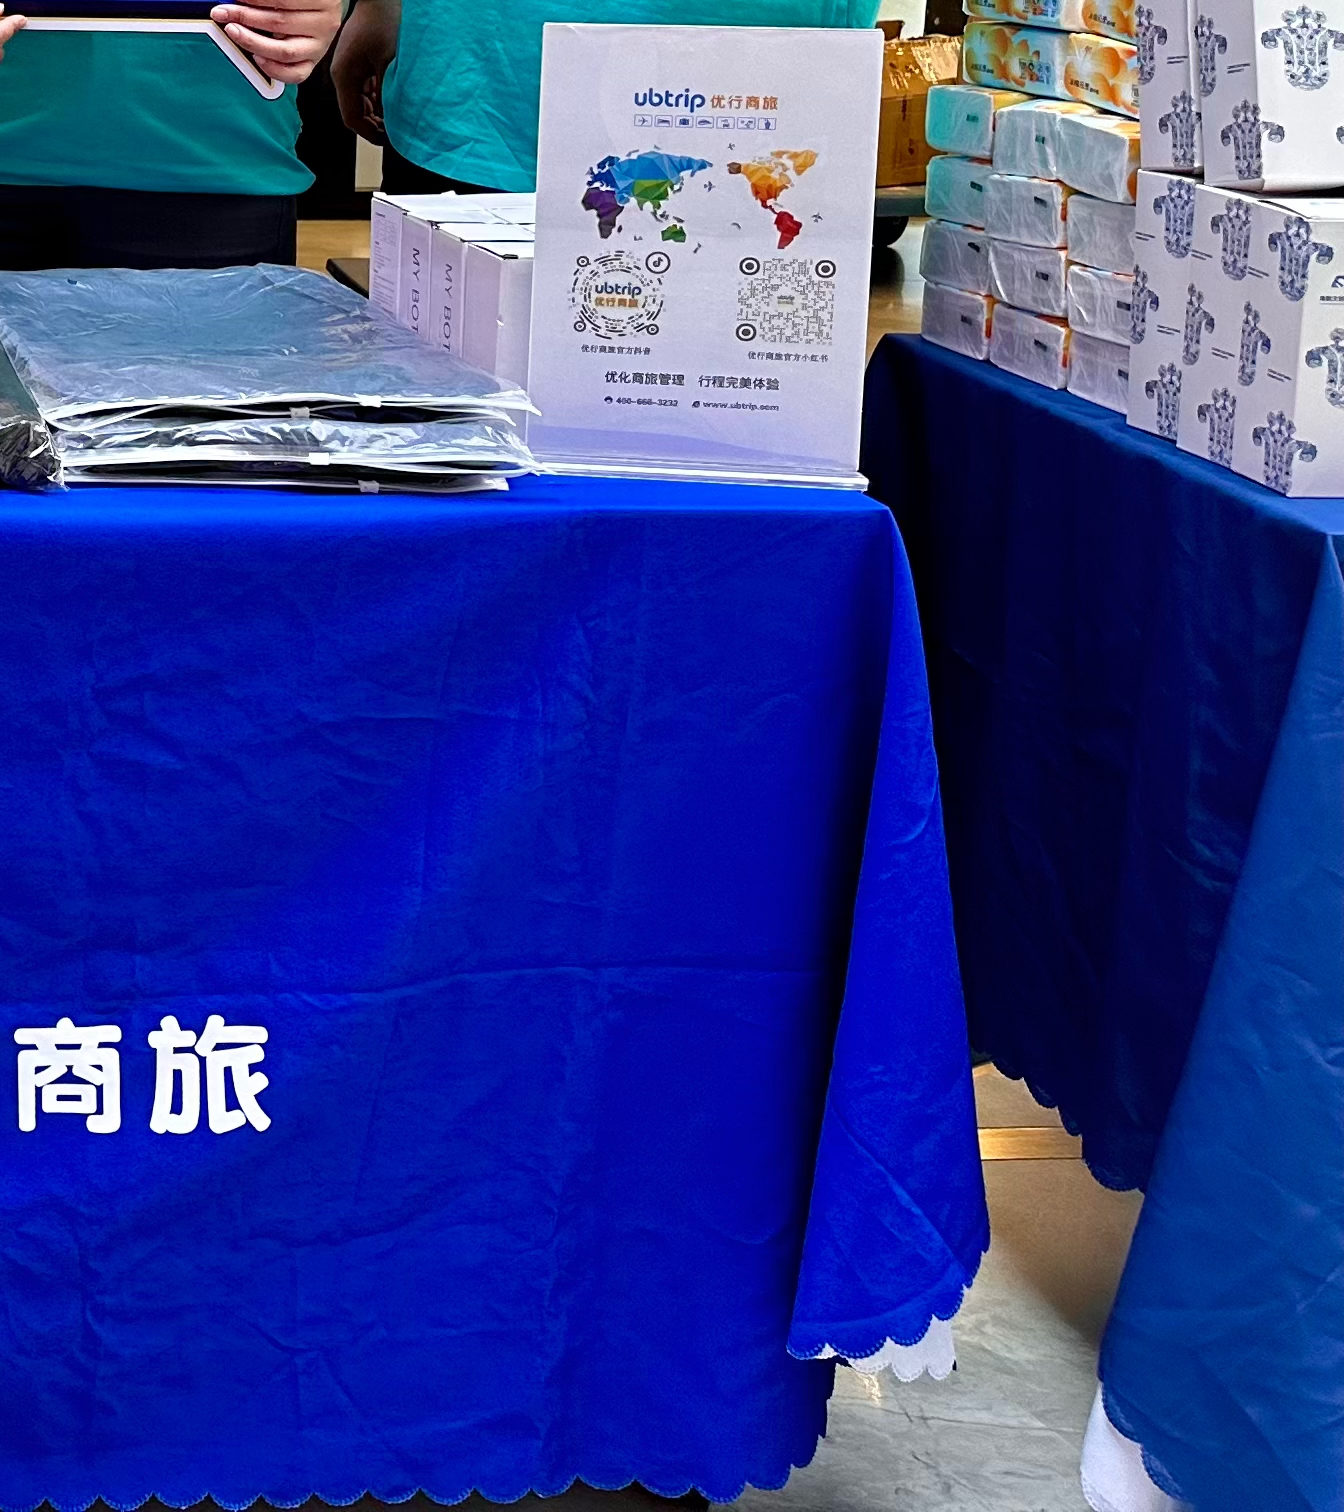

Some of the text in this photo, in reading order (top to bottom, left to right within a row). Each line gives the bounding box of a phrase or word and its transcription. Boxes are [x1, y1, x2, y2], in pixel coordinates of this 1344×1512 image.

[634, 88, 778, 112] ubtrip 优行商旅
[595, 282, 642, 298] ubtrip
[594, 296, 639, 308] 优行商旅
[604, 370, 780, 390] 优化商旅管理 行程完美体验
